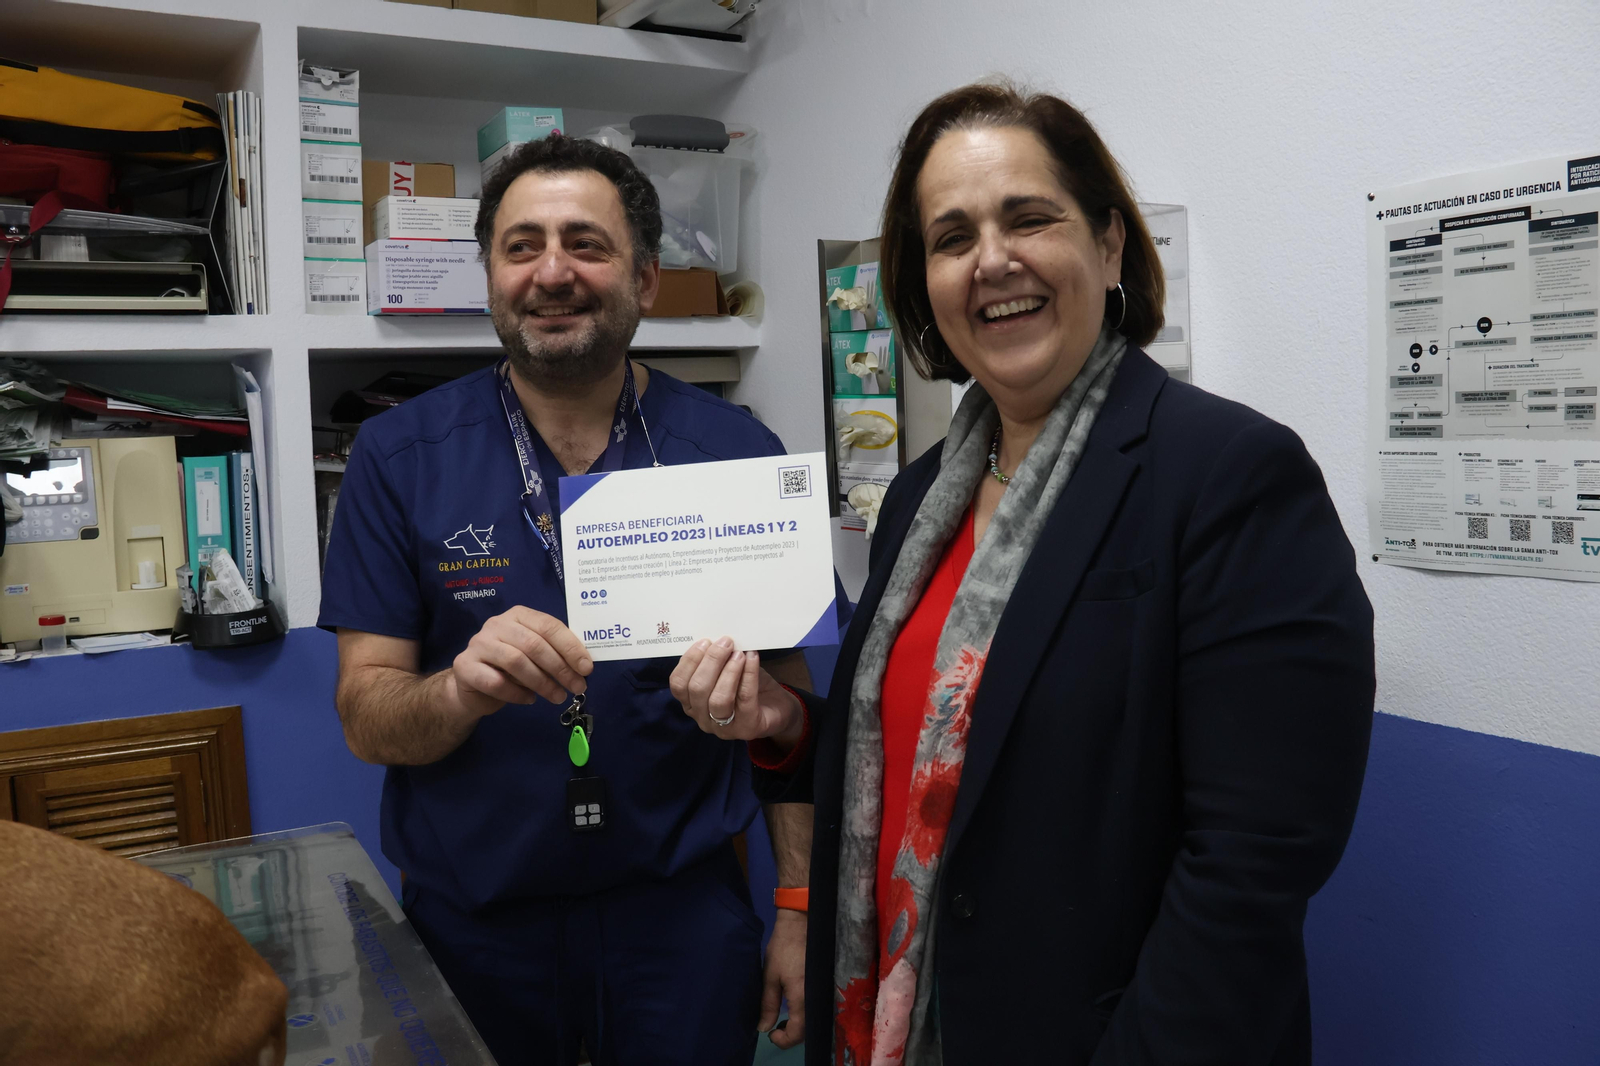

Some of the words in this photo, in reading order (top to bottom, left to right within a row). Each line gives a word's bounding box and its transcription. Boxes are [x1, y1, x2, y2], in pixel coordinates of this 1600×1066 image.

[394, 172, 411, 196] UY
[1386, 206, 1411, 218] PAUTAS
[1413, 204, 1422, 214] DE
[1424, 196, 1464, 212] ACTUACIÓN
[1467, 195, 1477, 205] EN
[1480, 191, 1500, 202] CASO
[1503, 188, 1514, 198] DE
[1516, 181, 1561, 196] URGENCIA
[387, 294, 403, 304] 100
[517, 410, 529, 441] ESPACIO
[243, 468, 255, 596] ONSENTIMIENTOS.
[576, 522, 625, 535] EMPRESA
[628, 514, 704, 530] BENEFICIARIA
[577, 532, 668, 550] AUTOEMPLEO
[671, 528, 706, 541] 2023
[715, 524, 765, 538] LÍNEAS
[768, 522, 774, 533] 1
[776, 521, 785, 532] Y
[788, 520, 797, 531] 2
[578, 557, 607, 566] Convocatoria
[673, 548, 714, 558] Emprendimiento
[718, 546, 742, 554] Proyectos
[751, 542, 781, 551] Autoempleo
[1466, 543, 1497, 551] INFORMACIÓN
[438, 561, 463, 572] GRAN
[466, 558, 510, 569] CAPITAN
[598, 566, 620, 574] Empresas
[689, 557, 712, 565] Empresas
[725, 553, 753, 562] desarrollen
[754, 552, 778, 560] proyectos
[608, 572, 643, 581] mantenimiento
[453, 588, 496, 601] VETERINARIO
[229, 616, 267, 628] FRONTLINE
[389, 997, 418, 1018] NO
